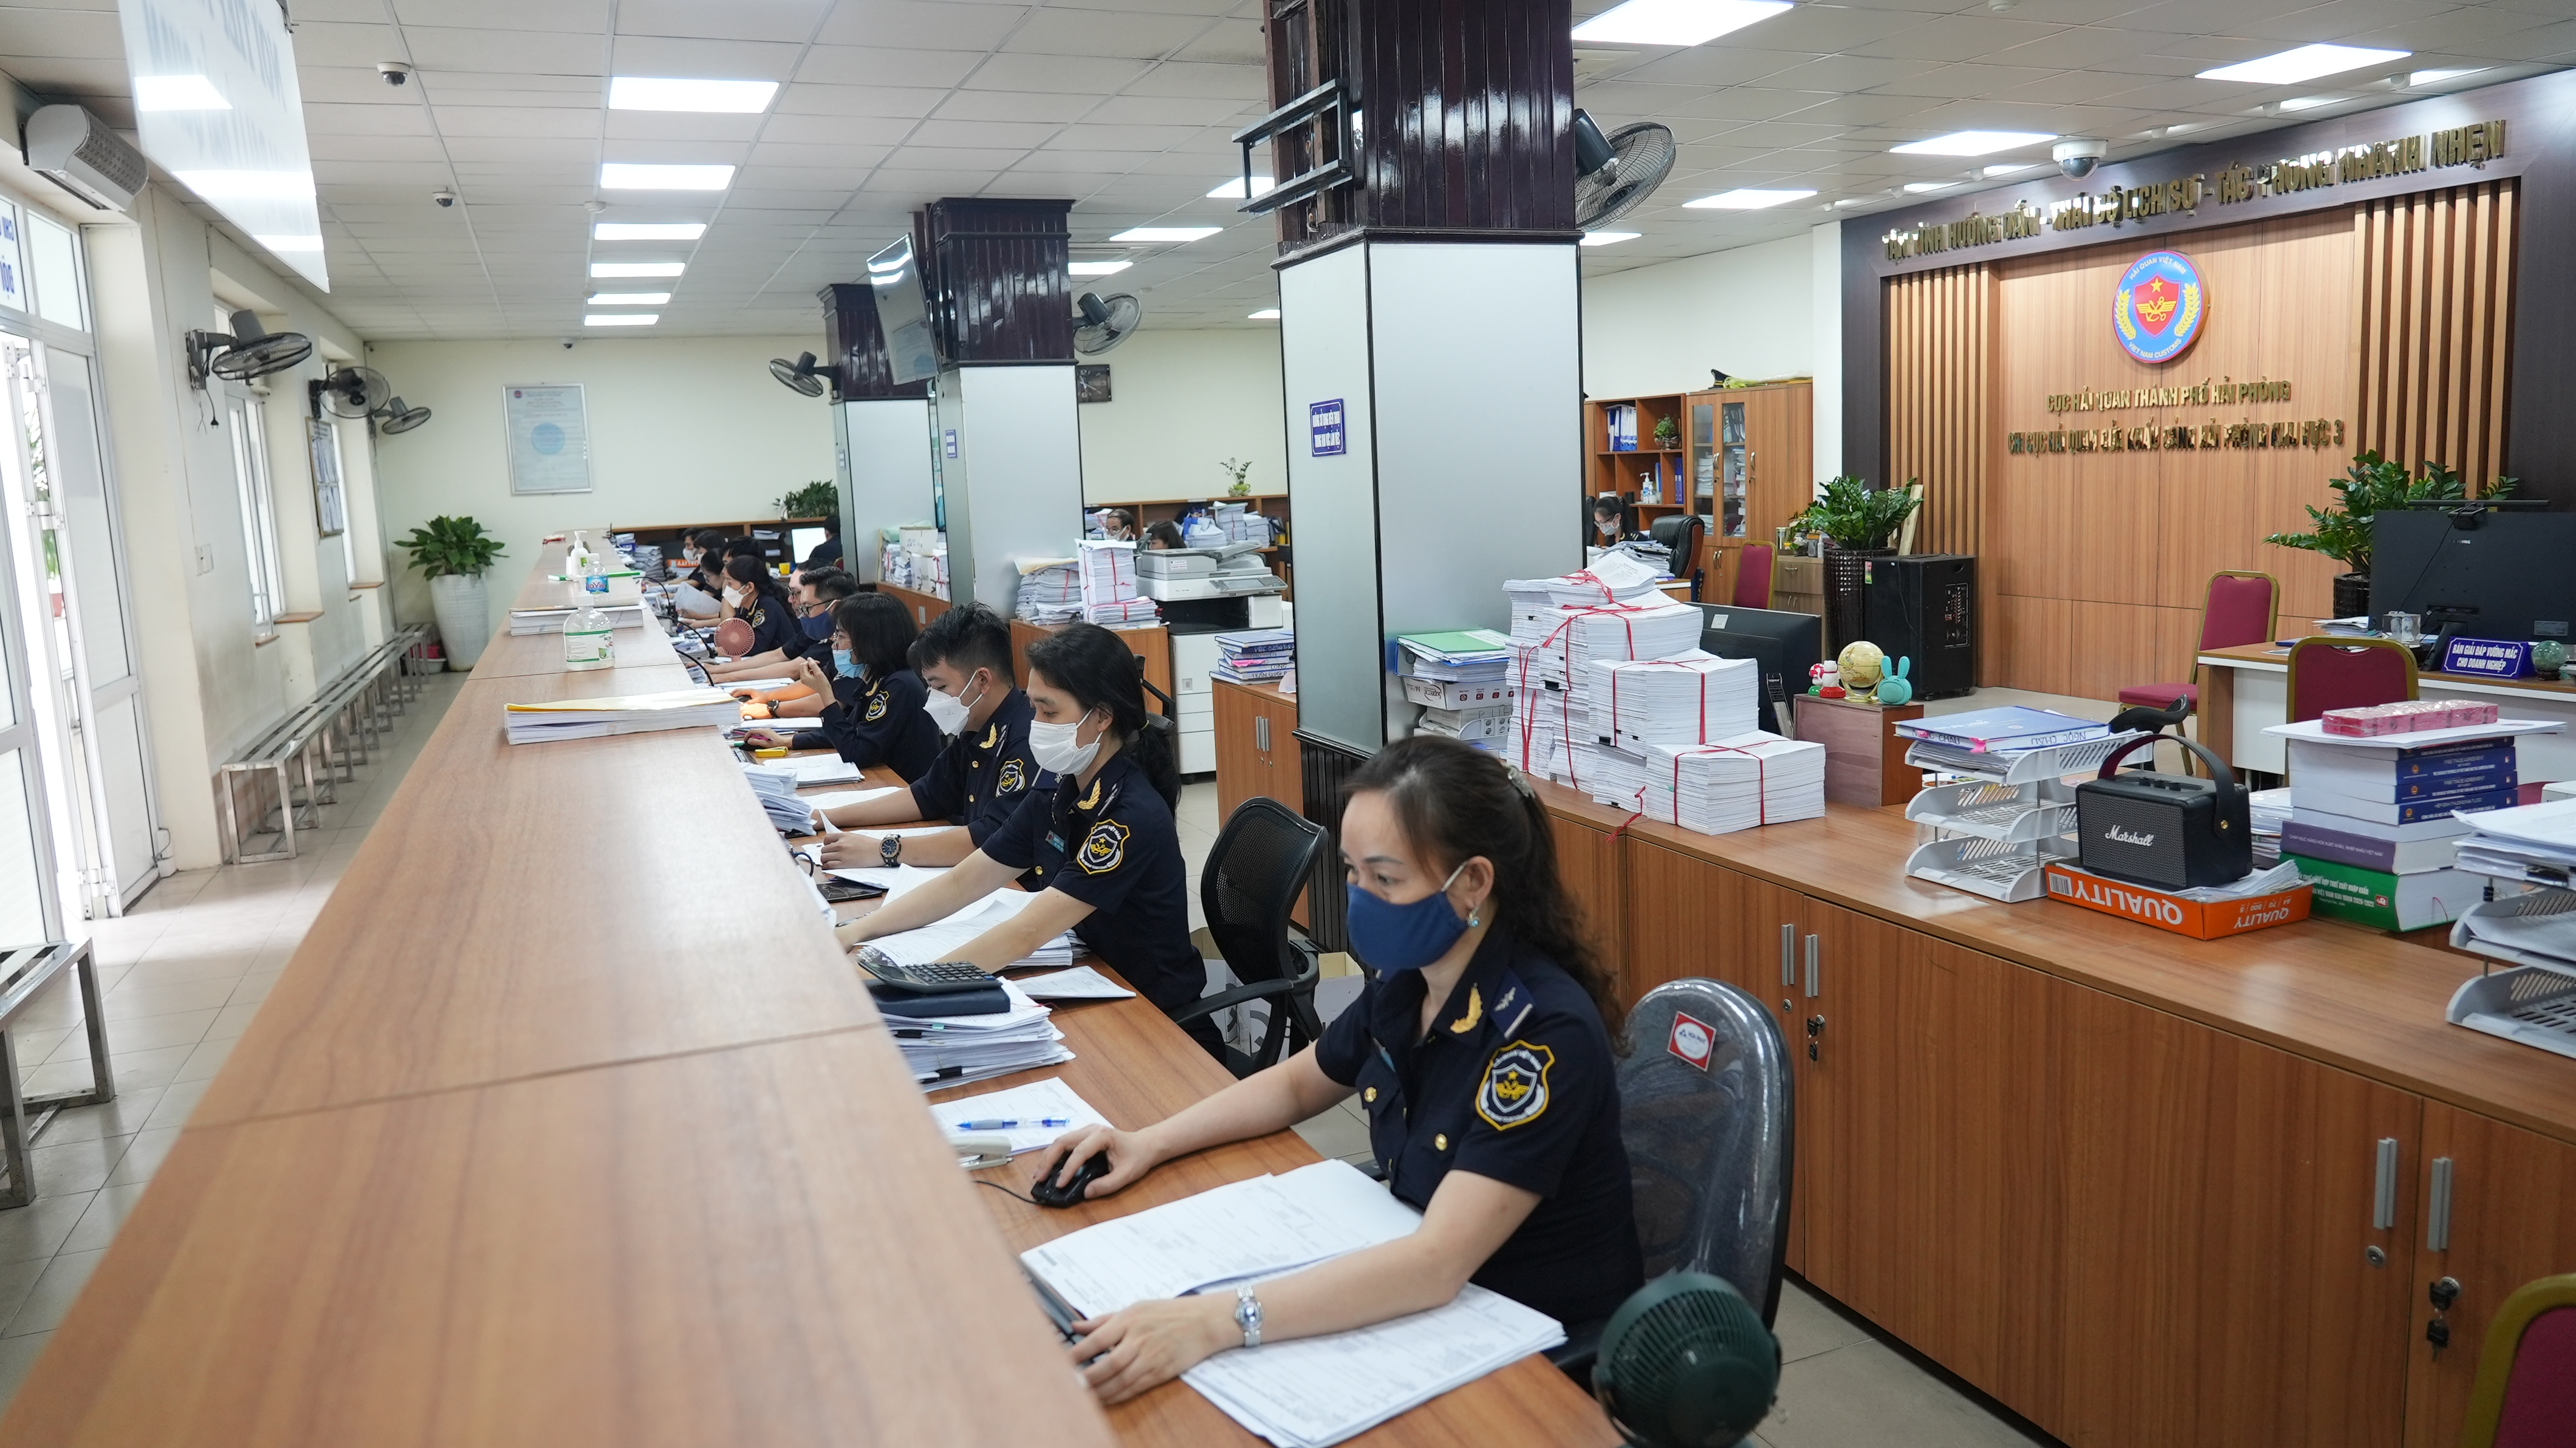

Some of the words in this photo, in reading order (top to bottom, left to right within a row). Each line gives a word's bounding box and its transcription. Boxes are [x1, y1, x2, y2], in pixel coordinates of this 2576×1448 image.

[2215, 160, 2255, 205] TÁC
[2431, 119, 2506, 170] NHẸN
[2129, 268, 2140, 280] HẢI
[2140, 257, 2157, 268] QUAN
[2173, 261, 2187, 275] NAM
[2129, 341, 2140, 353] VIET
[2154, 338, 2182, 358] CUSTOMS
[2047, 394, 2071, 417] CỤC
[2072, 385, 2094, 412] HẢI
[2096, 390, 2131, 411] QUAN
[2180, 377, 2210, 405] PHỐ
[2238, 376, 2292, 403] PHÒNG
[2333, 419, 2345, 446] 3
[2452, 643, 2464, 654] BÀN
[2464, 641, 2475, 655] GIẢI
[2475, 644, 2487, 656] ĐÁP
[2487, 645, 2504, 658] VƯỚNG
[2504, 646, 2518, 659] MẮC
[2456, 657, 2468, 668] CHO
[2467, 658, 2486, 669] DOANH
[2485, 659, 2507, 673] NGHIỆP
[2105, 825, 2154, 846] Marshall
[2075, 879, 2182, 925] QUALITY
[2233, 907, 2289, 929] QUALITY
